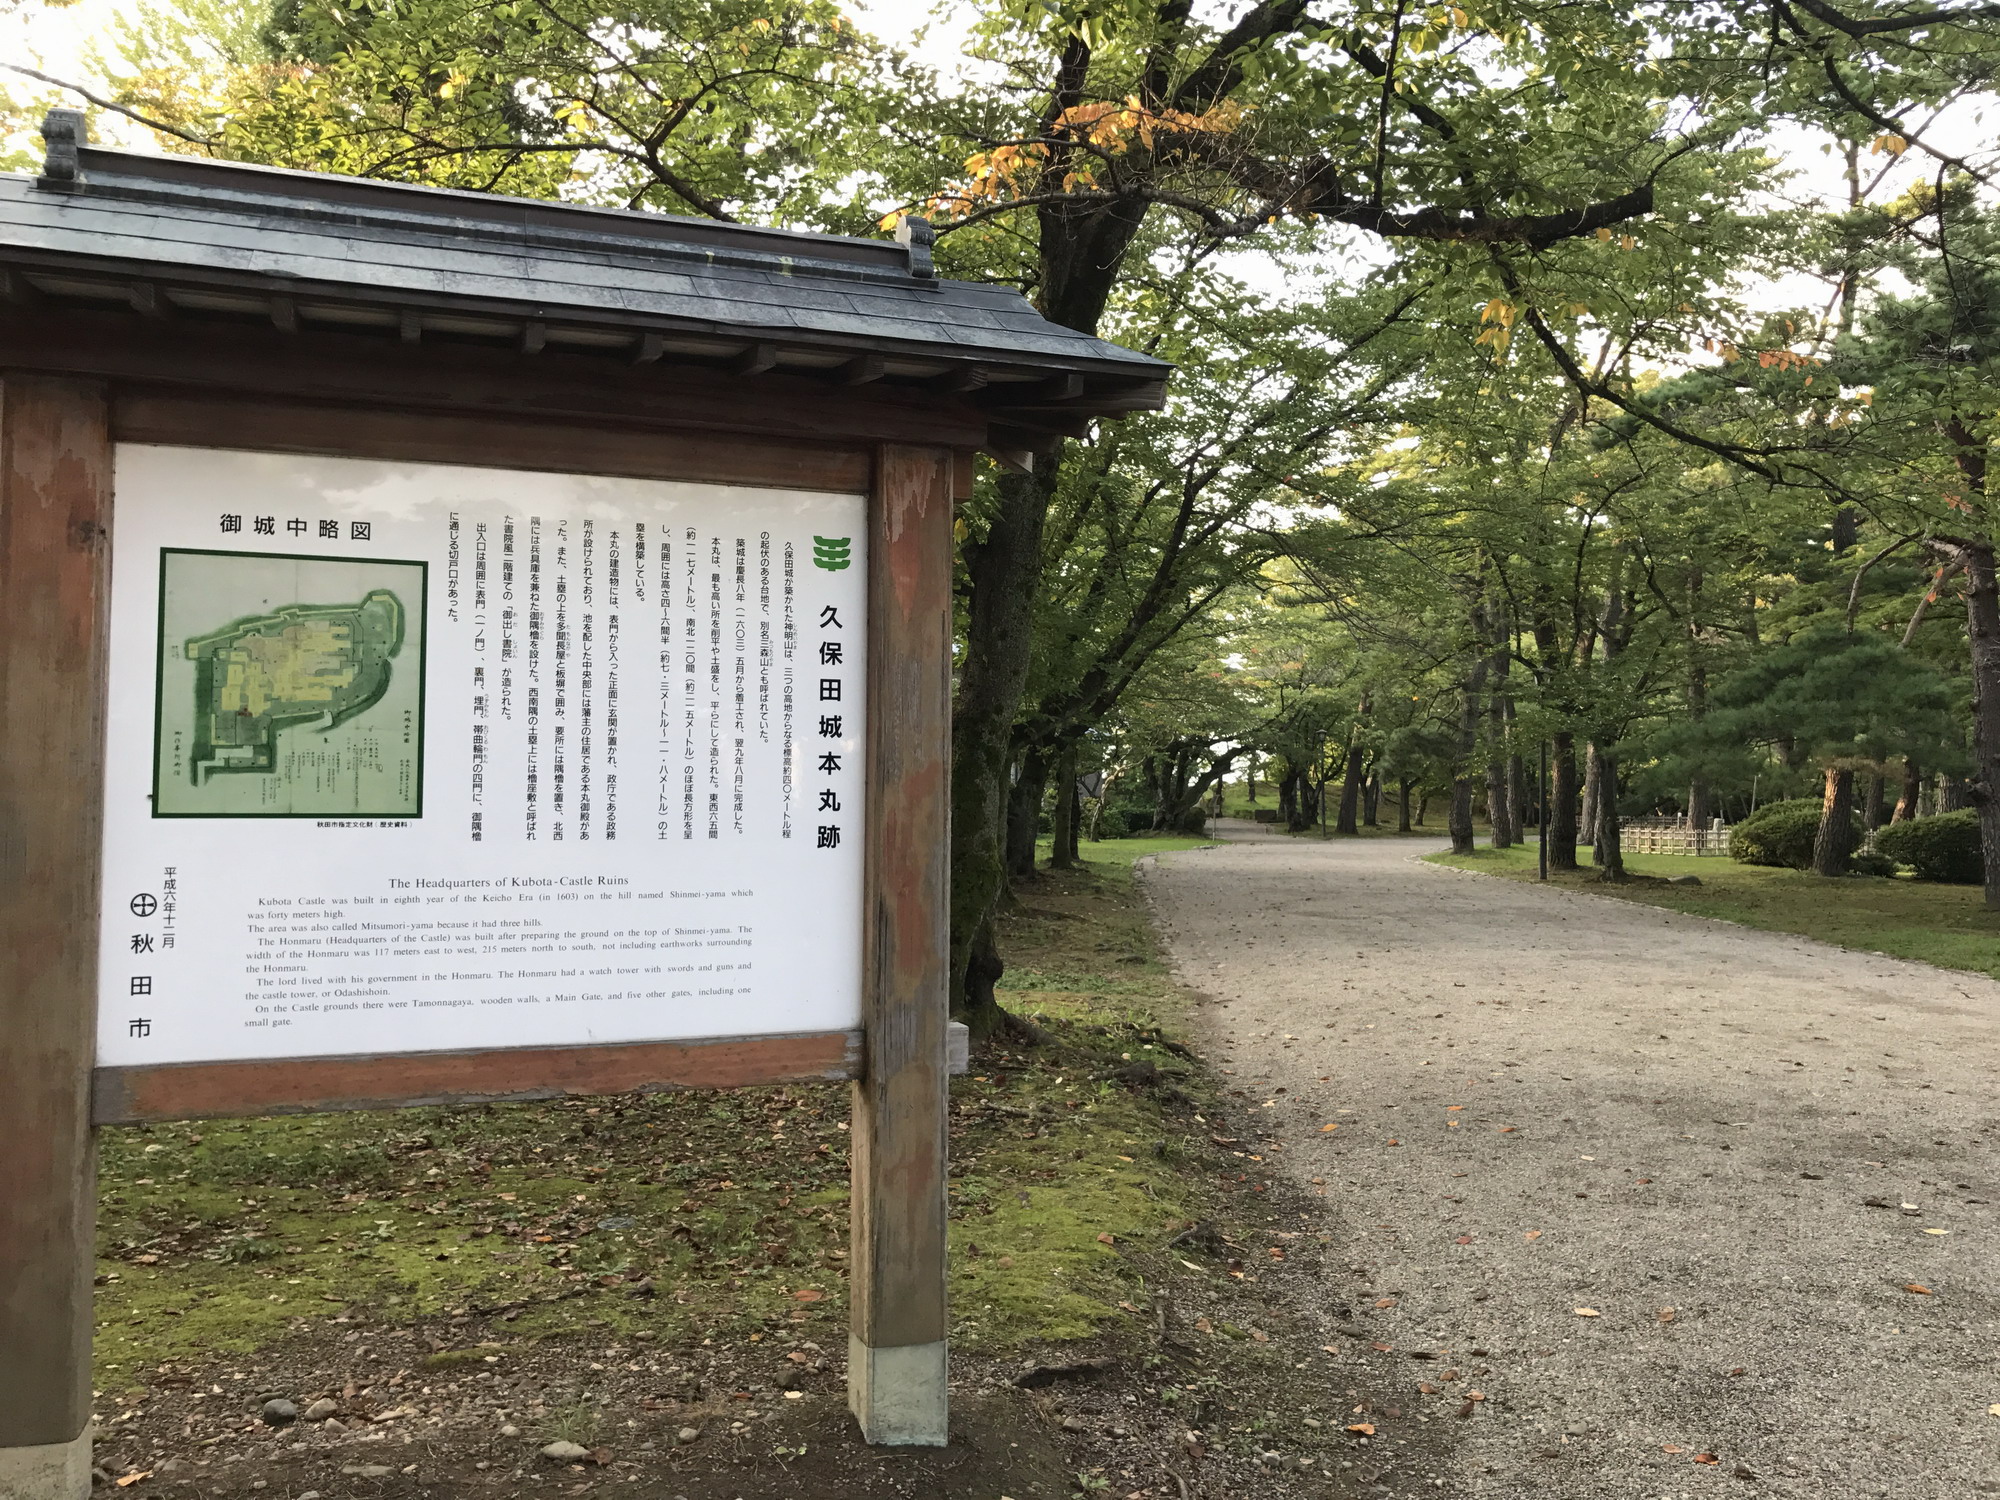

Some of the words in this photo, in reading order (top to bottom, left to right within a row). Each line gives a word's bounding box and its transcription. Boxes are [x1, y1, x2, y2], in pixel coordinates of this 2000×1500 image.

[220, 513, 372, 542] 御城中略図
[448, 511, 460, 623] に通じる切戸口があった。
[635, 522, 646, 602] 塁を構築している。
[501, 515, 515, 721] た書院風二階建ての「御出し書院」が造られた。
[759, 531, 770, 744] の起伏のある台地で、別名三森山とも呼ばれていた。
[526, 516, 541, 841] 隅には兵具庫を兼ねた御隅櫓を設けた。西南隅の土塁上には櫓座敷と呼ばれ
[579, 519, 593, 841] 所が設けられており、池を配した中央部には藩主の住居である本丸御殿があ
[606, 531, 620, 841] 本丸の建造物には、表門から入った正面に玄関が置かれ、政庁である政務
[708, 537, 721, 839] 本丸は、最も高い所を削平や土盛をし、平らにして造られた。東西六五間
[733, 538, 745, 835] 築城は慶長八年（一六〇三）五月から着工され、翌九年八月に完成した。
[816, 604, 843, 849] 久保田城本丸跡
[162, 866, 177, 949] 平成六年十二月
[258, 896, 291, 906] Kubota
[297, 896, 325, 905] Castle
[353, 895, 373, 904] built
[379, 895, 388, 904] in
[393, 894, 420, 906] eighth
[426, 896, 444, 905] year
[449, 893, 459, 902] of
[463, 893, 477, 902] the
[482, 893, 512, 902] Keicho
[518, 892, 533, 901] Era
[538, 892, 550, 903] (in
[557, 891, 578, 903] 1603)
[600, 891, 612, 900] the
[618, 890, 631, 899] hill
[637, 890, 663, 899] named
[669, 889, 725, 901] Shinmei-yama
[731, 888, 753, 898] which
[388, 877, 410, 889] The
[415, 876, 490, 891] Headquarters
[494, 876, 508, 887] of
[511, 875, 593, 887] Kubota-Castle
[597, 874, 628, 885] Ruins
[247, 924, 265, 933] The
[310, 922, 329, 932] also
[331, 922, 357, 931] called
[360, 920, 433, 933] Mitsumori-yama
[436, 920, 469, 929] because
[471, 919, 478, 928] it
[481, 919, 497, 928] had
[499, 918, 520, 928] three
[523, 918, 543, 927] hills.
[256, 937, 275, 946] The
[279, 936, 322, 946] Honmaru
[325, 934, 387, 947] (Headquarters
[390, 934, 401, 943] of
[403, 933, 417, 942] the
[420, 932, 450, 944] Castle)
[474, 931, 494, 940] built
[497, 931, 516, 940] after
[520, 929, 560, 941] preparing
[563, 929, 576, 938] the
[580, 928, 609, 940] ground
[627, 927, 640, 936] the
[644, 928, 658, 938] top
[661, 926, 671, 935] of
[674, 925, 732, 937] Shinmei-yama.
[737, 924, 752, 933] The
[267, 910, 288, 921] forty
[292, 910, 320, 919] meters
[323, 909, 345, 920] high.
[245, 950, 271, 960] width
[275, 950, 286, 959] of
[289, 949, 303, 959] the
[307, 948, 349, 958] Honmaru
[375, 947, 389, 956] 117
[393, 947, 420, 956] meters
[423, 947, 440, 955] east
[443, 946, 452, 954] to
[456, 946, 477, 955] west,
[482, 944, 497, 953] 215
[500, 944, 526, 953] meters
[531, 942, 553, 952] north
[558, 943, 567, 951] to
[571, 941, 596, 952] south,
[602, 942, 615, 950] not
[619, 940, 656, 952] including
[659, 938, 702, 948] earthworks
[706, 937, 752, 949] surrounding
[245, 964, 260, 973] the
[263, 963, 308, 973] Honmaru.
[255, 977, 274, 986] The
[278, 976, 297, 986] lord
[301, 975, 322, 985] lived
[327, 975, 346, 984] with
[350, 974, 364, 983] his
[367, 973, 417, 985] government
[421, 972, 430, 981] in
[434, 971, 447, 980] the
[451, 970, 493, 980] Honmaru.
[497, 969, 514, 978] The
[517, 968, 557, 978] Honmaru
[560, 967, 576, 976] had
[588, 966, 612, 975] watch
[616, 966, 639, 974] tower
[643, 964, 661, 973] with
[667, 963, 694, 973] swords
[697, 962, 712, 972] and
[715, 964, 734, 973] guns
[737, 961, 751, 970] and
[129, 933, 154, 1038] 秋田市
[245, 991, 259, 1000] the
[262, 990, 287, 1000] castle
[290, 990, 317, 1000] tower,
[334, 987, 390, 997] Odashishoin.
[254, 1004, 269, 1013] On
[273, 1003, 287, 1012] the
[291, 1002, 319, 1012] Castle
[323, 1000, 359, 1013] grounds
[362, 999, 384, 1009] there
[411, 997, 474, 1008] Tamonnagaya,
[480, 994, 512, 1004] wooden
[516, 993, 540, 1004] walls,
[554, 992, 576, 1001] Main
[581, 991, 603, 1002] Gate,
[607, 990, 622, 999] and
[626, 989, 641, 999] five
[645, 988, 666, 998] other
[671, 988, 692, 999] gates,
[698, 986, 734, 998] including
[244, 1017, 268, 1027] small
[272, 1018, 292, 1028] gate.
